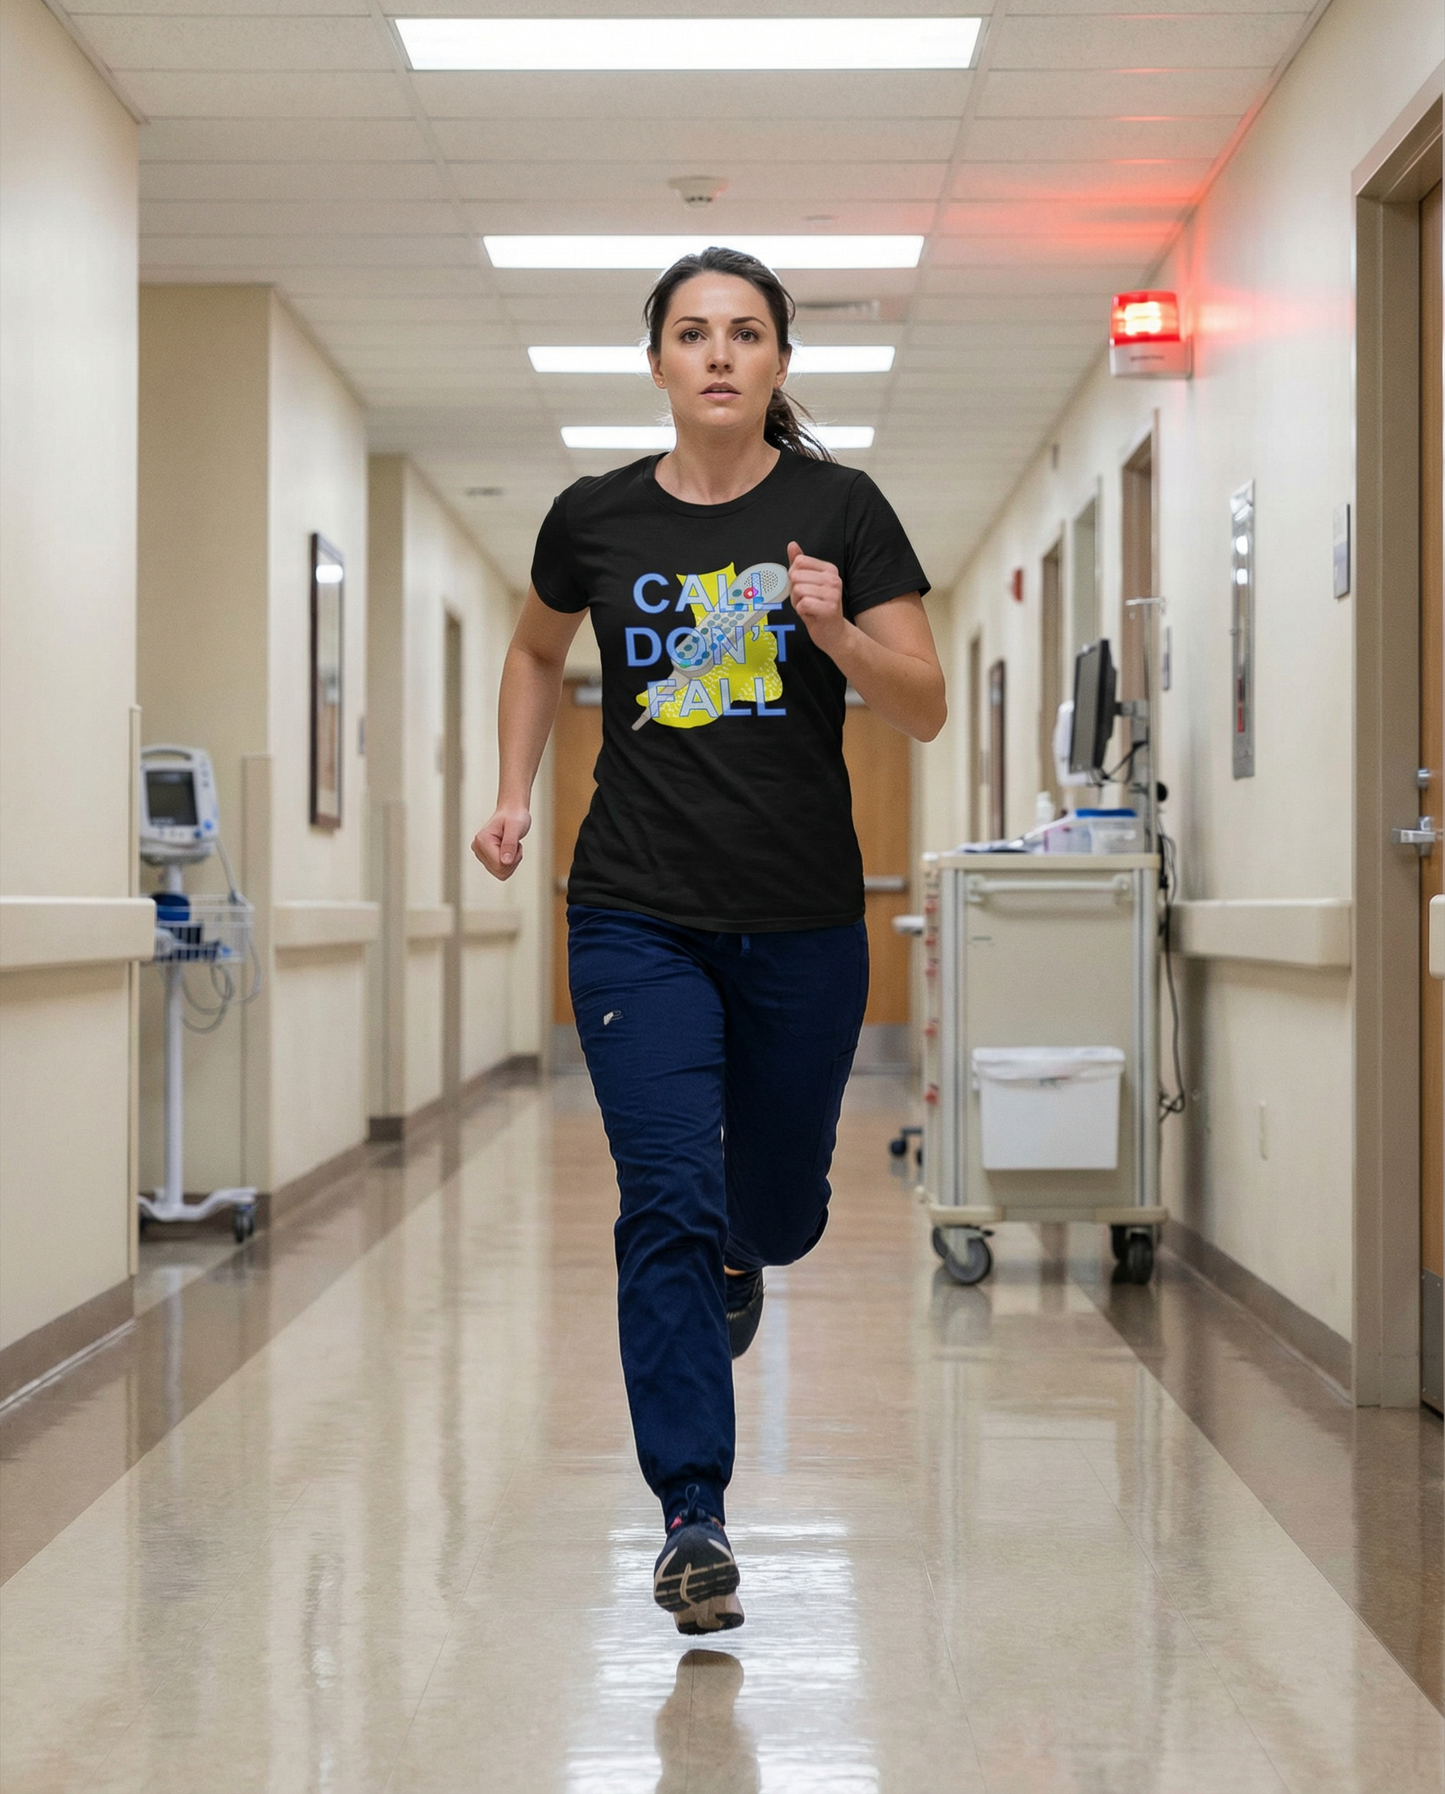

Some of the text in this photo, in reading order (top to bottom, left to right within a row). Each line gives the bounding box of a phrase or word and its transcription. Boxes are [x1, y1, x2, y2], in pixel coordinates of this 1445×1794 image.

[632, 572, 783, 614] CALL
[624, 624, 796, 667] DON'T
[647, 677, 787, 718] FALL
